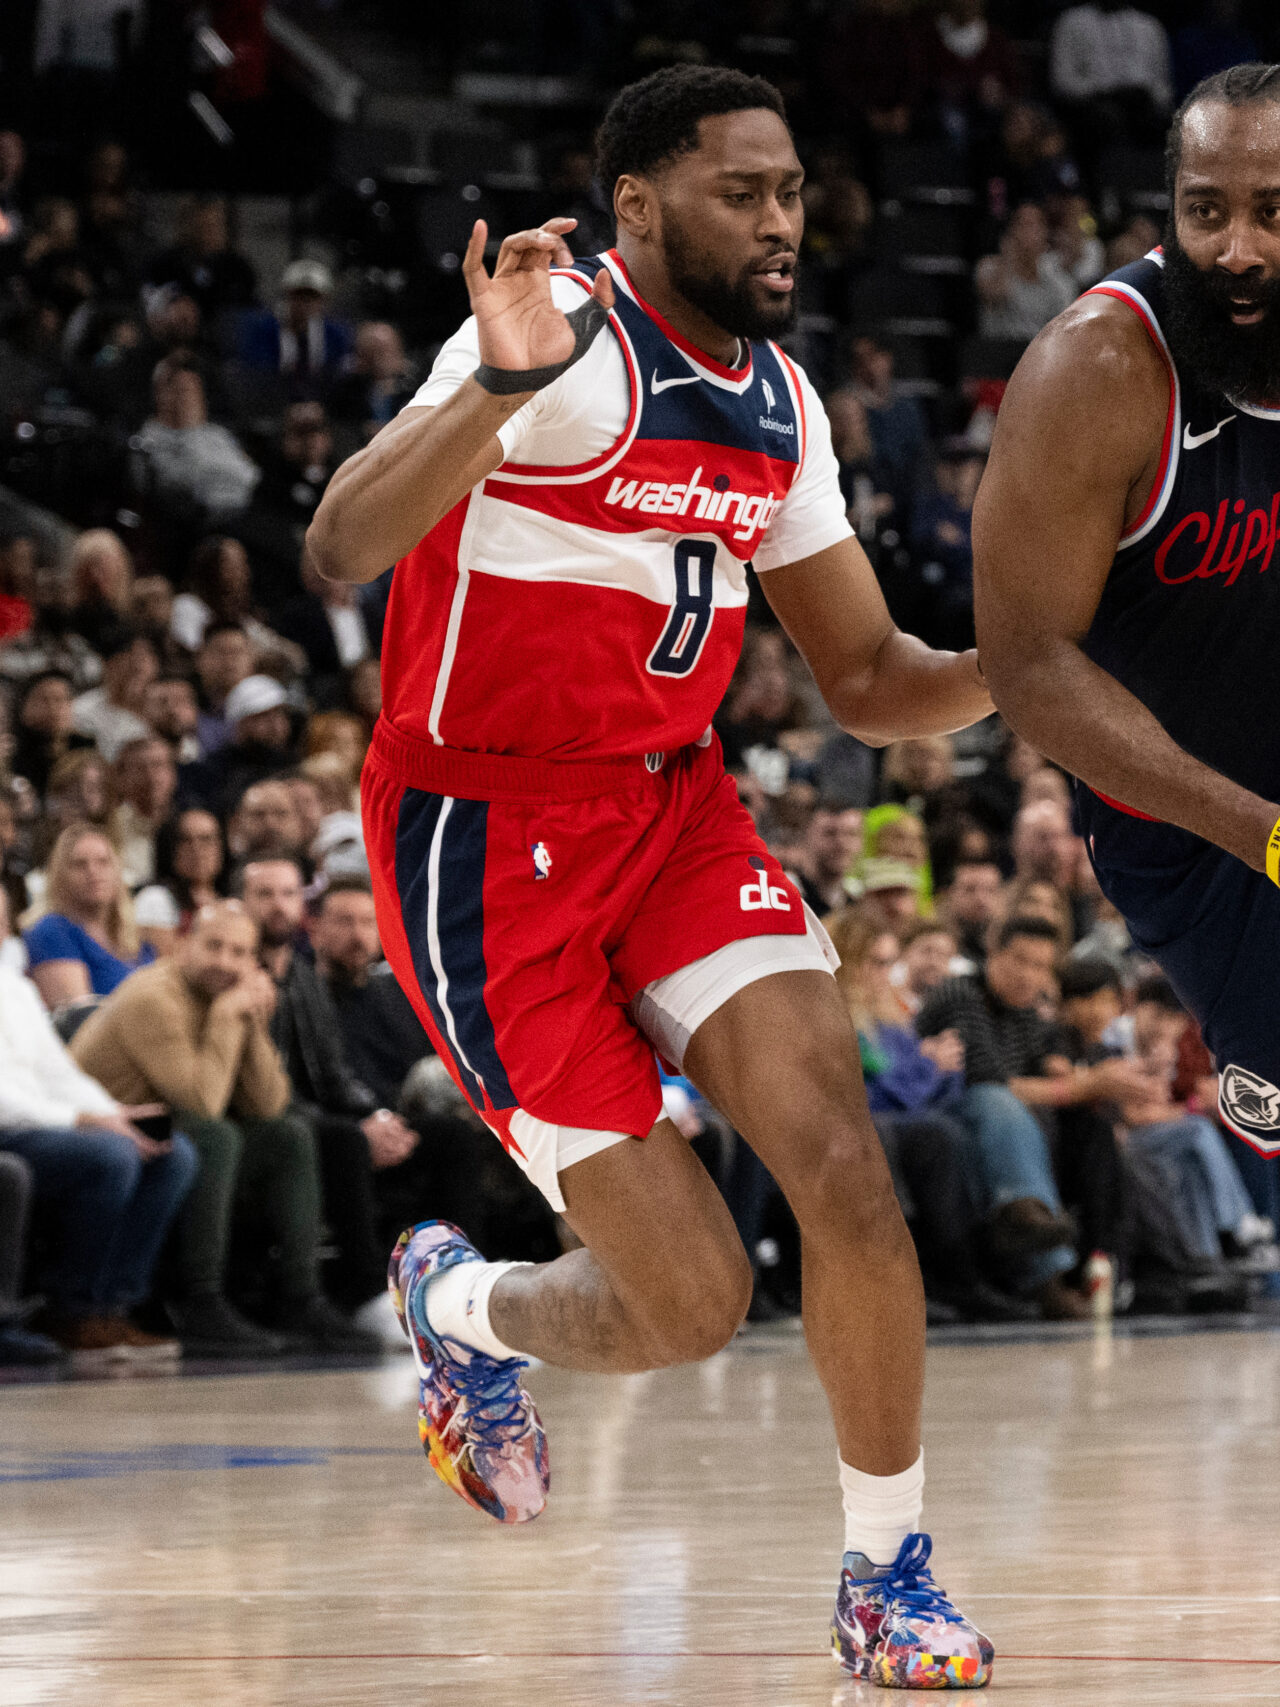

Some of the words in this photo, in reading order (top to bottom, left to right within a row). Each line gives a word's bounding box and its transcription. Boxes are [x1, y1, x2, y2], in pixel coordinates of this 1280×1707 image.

[759, 415, 794, 435] Robinhood
[604, 466, 780, 541] washingt
[646, 537, 717, 678] 8
[740, 868, 791, 911] dc
